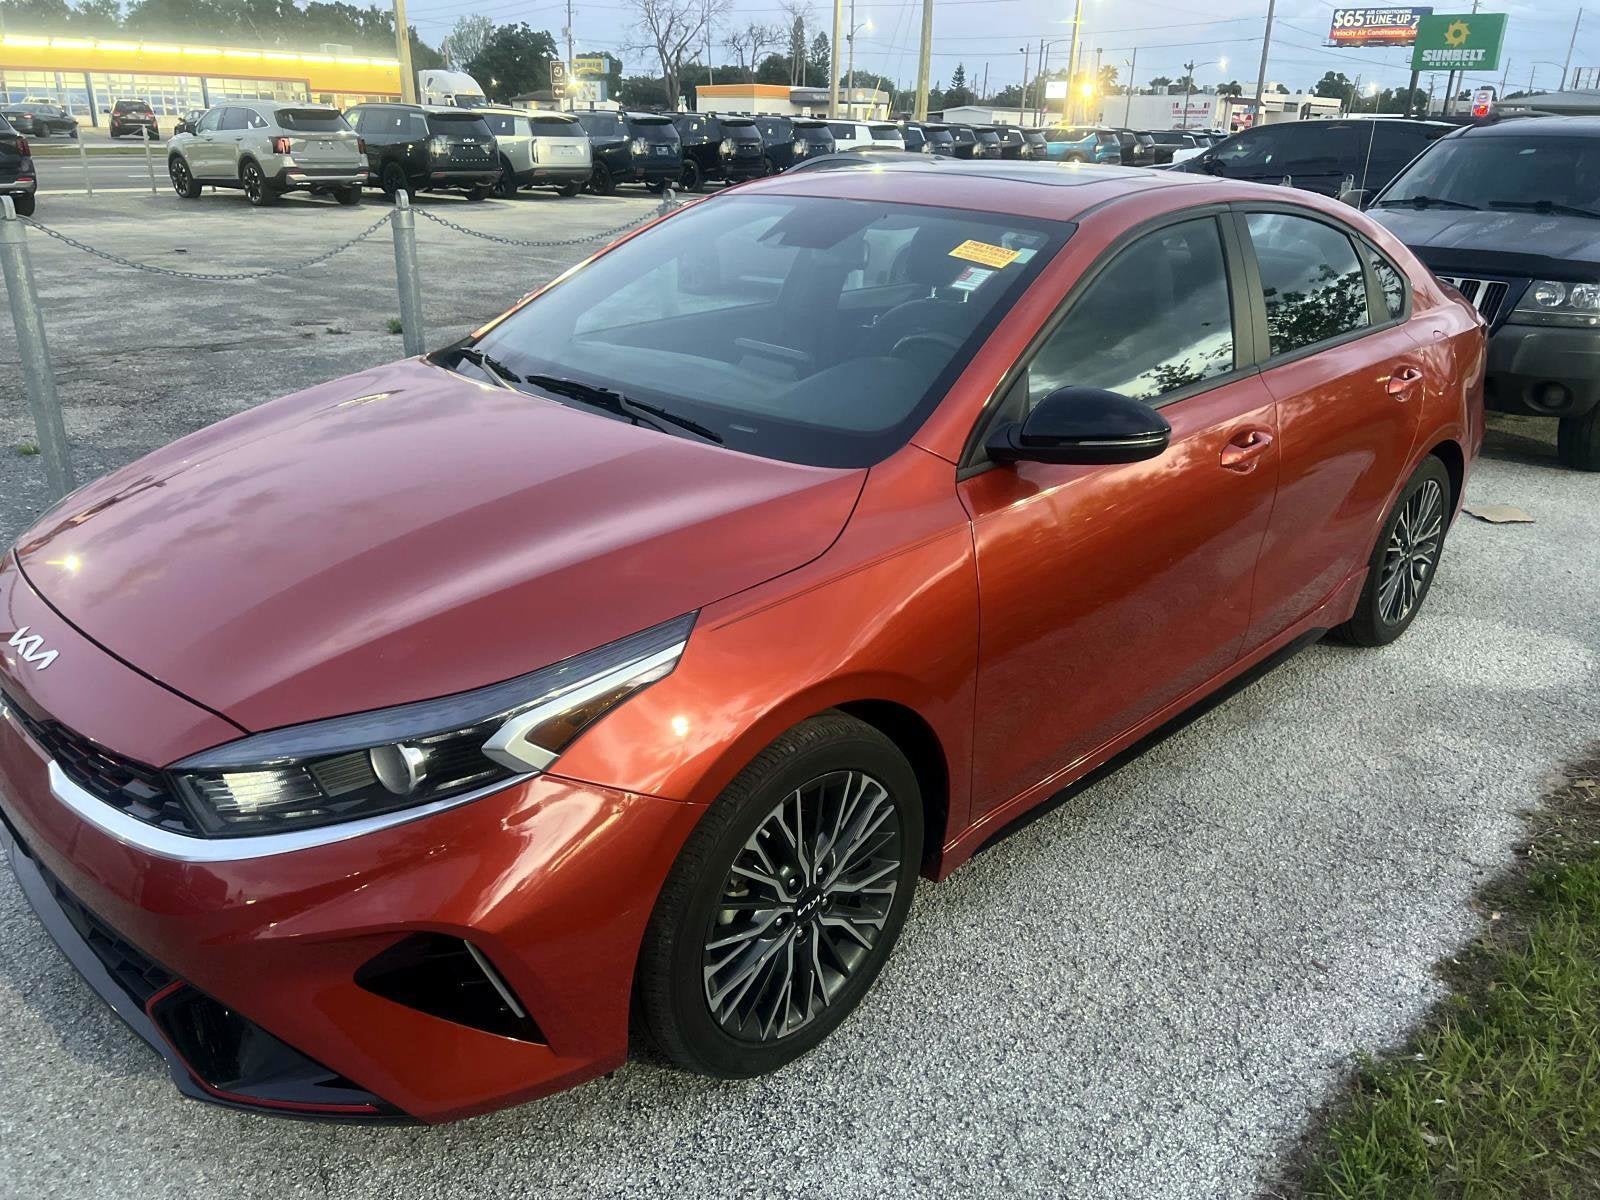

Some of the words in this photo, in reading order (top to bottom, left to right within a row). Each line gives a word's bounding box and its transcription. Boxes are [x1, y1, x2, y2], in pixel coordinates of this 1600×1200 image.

[1333, 10, 1365, 28] $65
[1366, 14, 1411, 25] TUNE-UP
[1333, 29, 1356, 37] Velocity
[1422, 49, 1486, 61] SUNBELT
[8, 625, 60, 670] KIA
